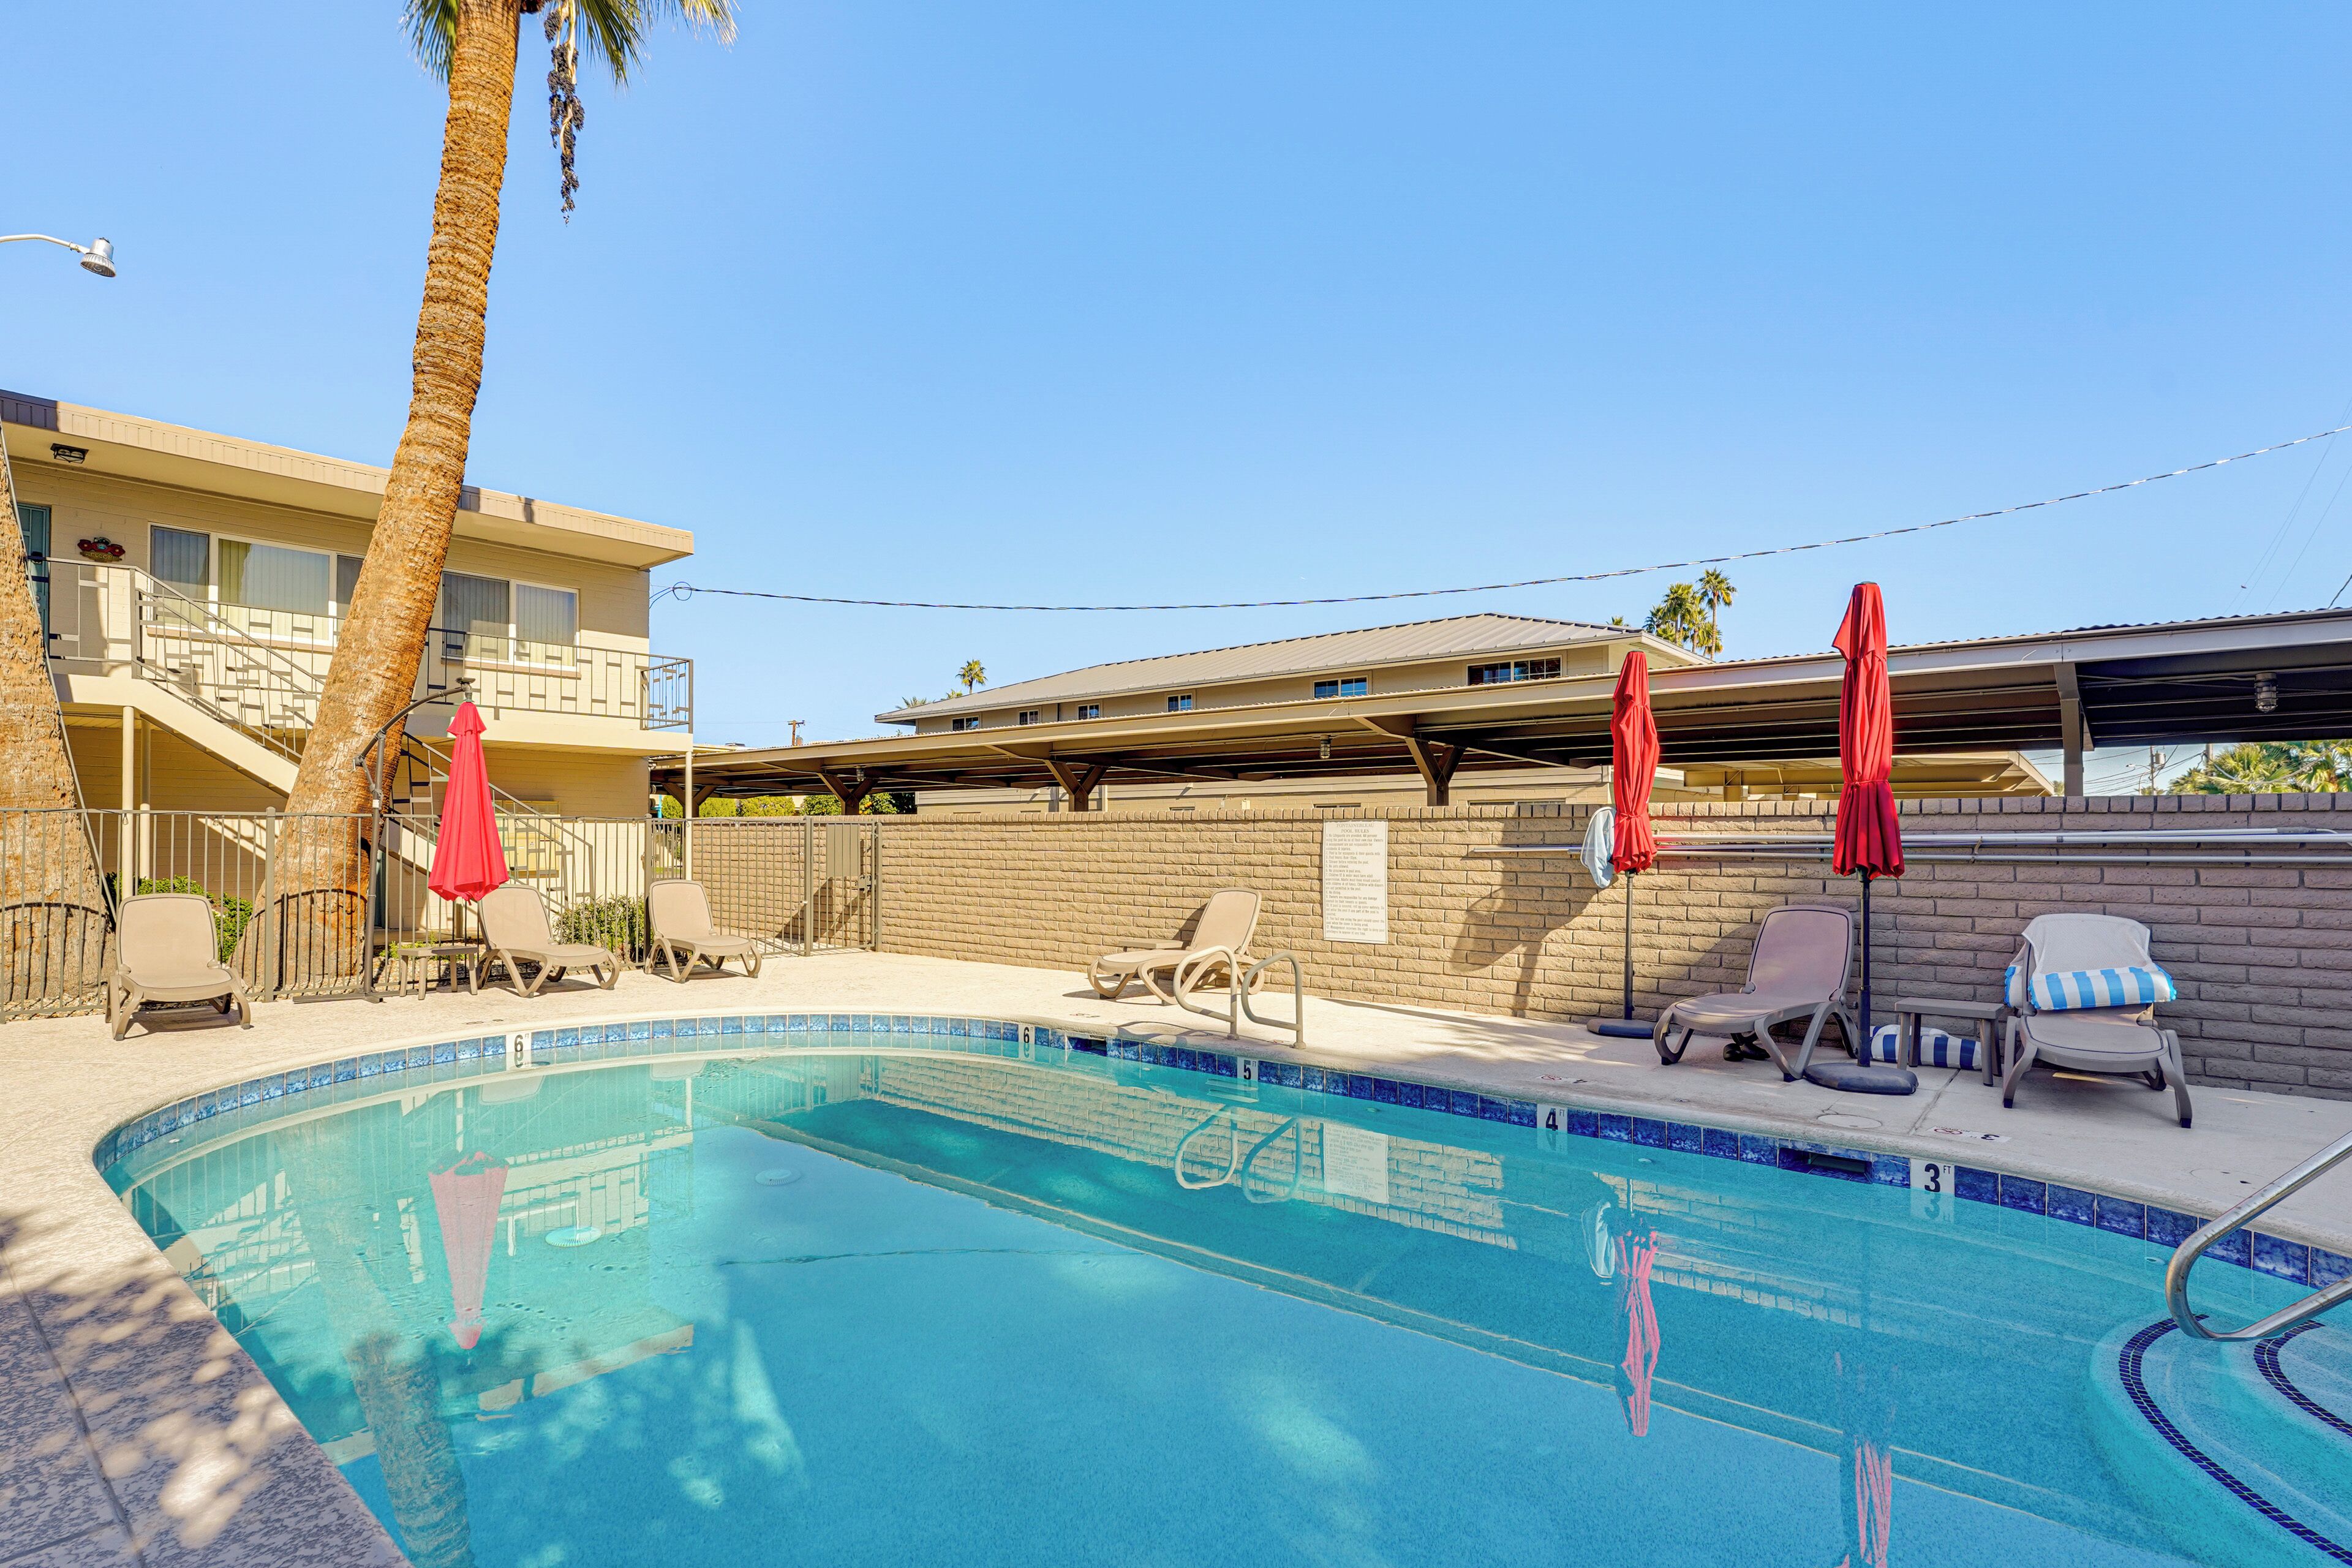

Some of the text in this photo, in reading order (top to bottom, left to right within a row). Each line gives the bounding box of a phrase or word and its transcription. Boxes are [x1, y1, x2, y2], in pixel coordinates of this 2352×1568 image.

[514, 1035, 523, 1052] 6
[1023, 1027, 1030, 1044] 6
[1243, 1060, 1251, 1080] 5
[1545, 1108, 1558, 1131] 4
[1924, 1163, 1951, 1193] 3 FT
